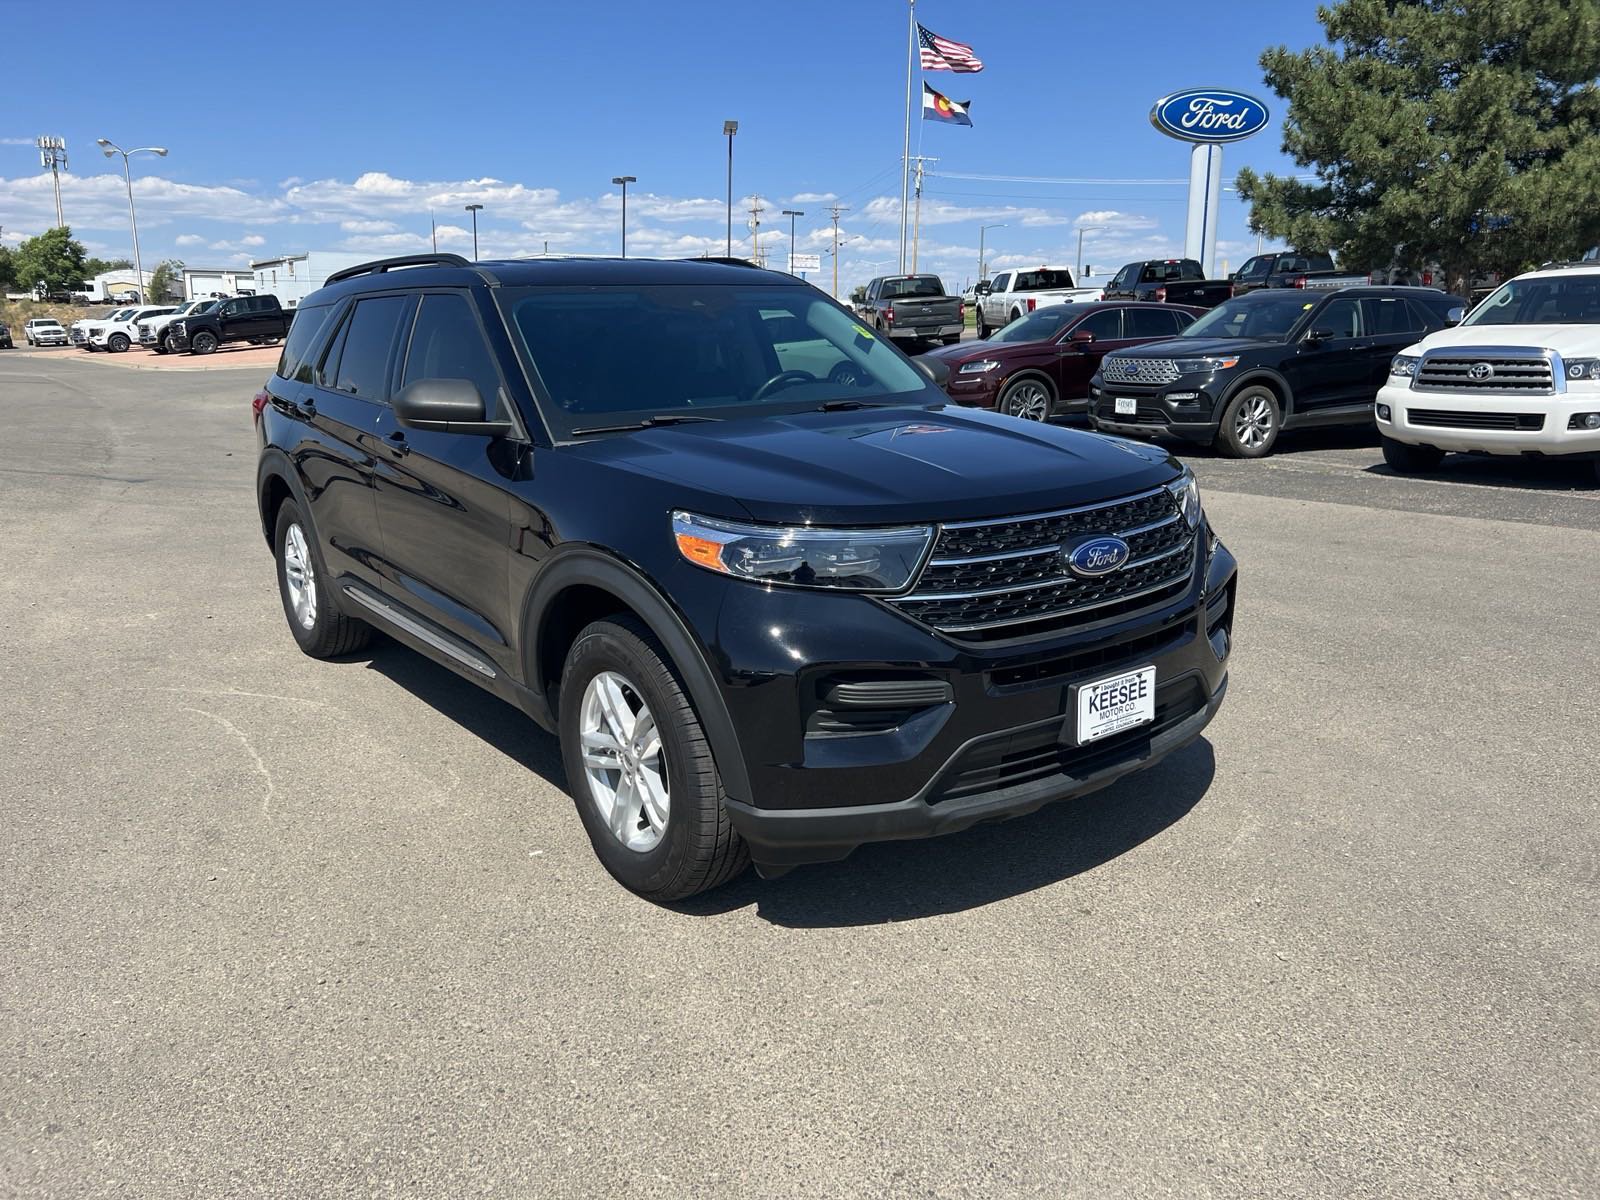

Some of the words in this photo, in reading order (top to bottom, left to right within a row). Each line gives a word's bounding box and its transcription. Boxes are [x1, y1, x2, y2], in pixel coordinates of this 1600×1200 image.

[1181, 98, 1250, 129] Ford
[1087, 545, 1118, 568] Ford
[1089, 679, 1147, 715] KEESEE
[1100, 706, 1124, 720] MOTOR
[1125, 702, 1136, 712] CO.
